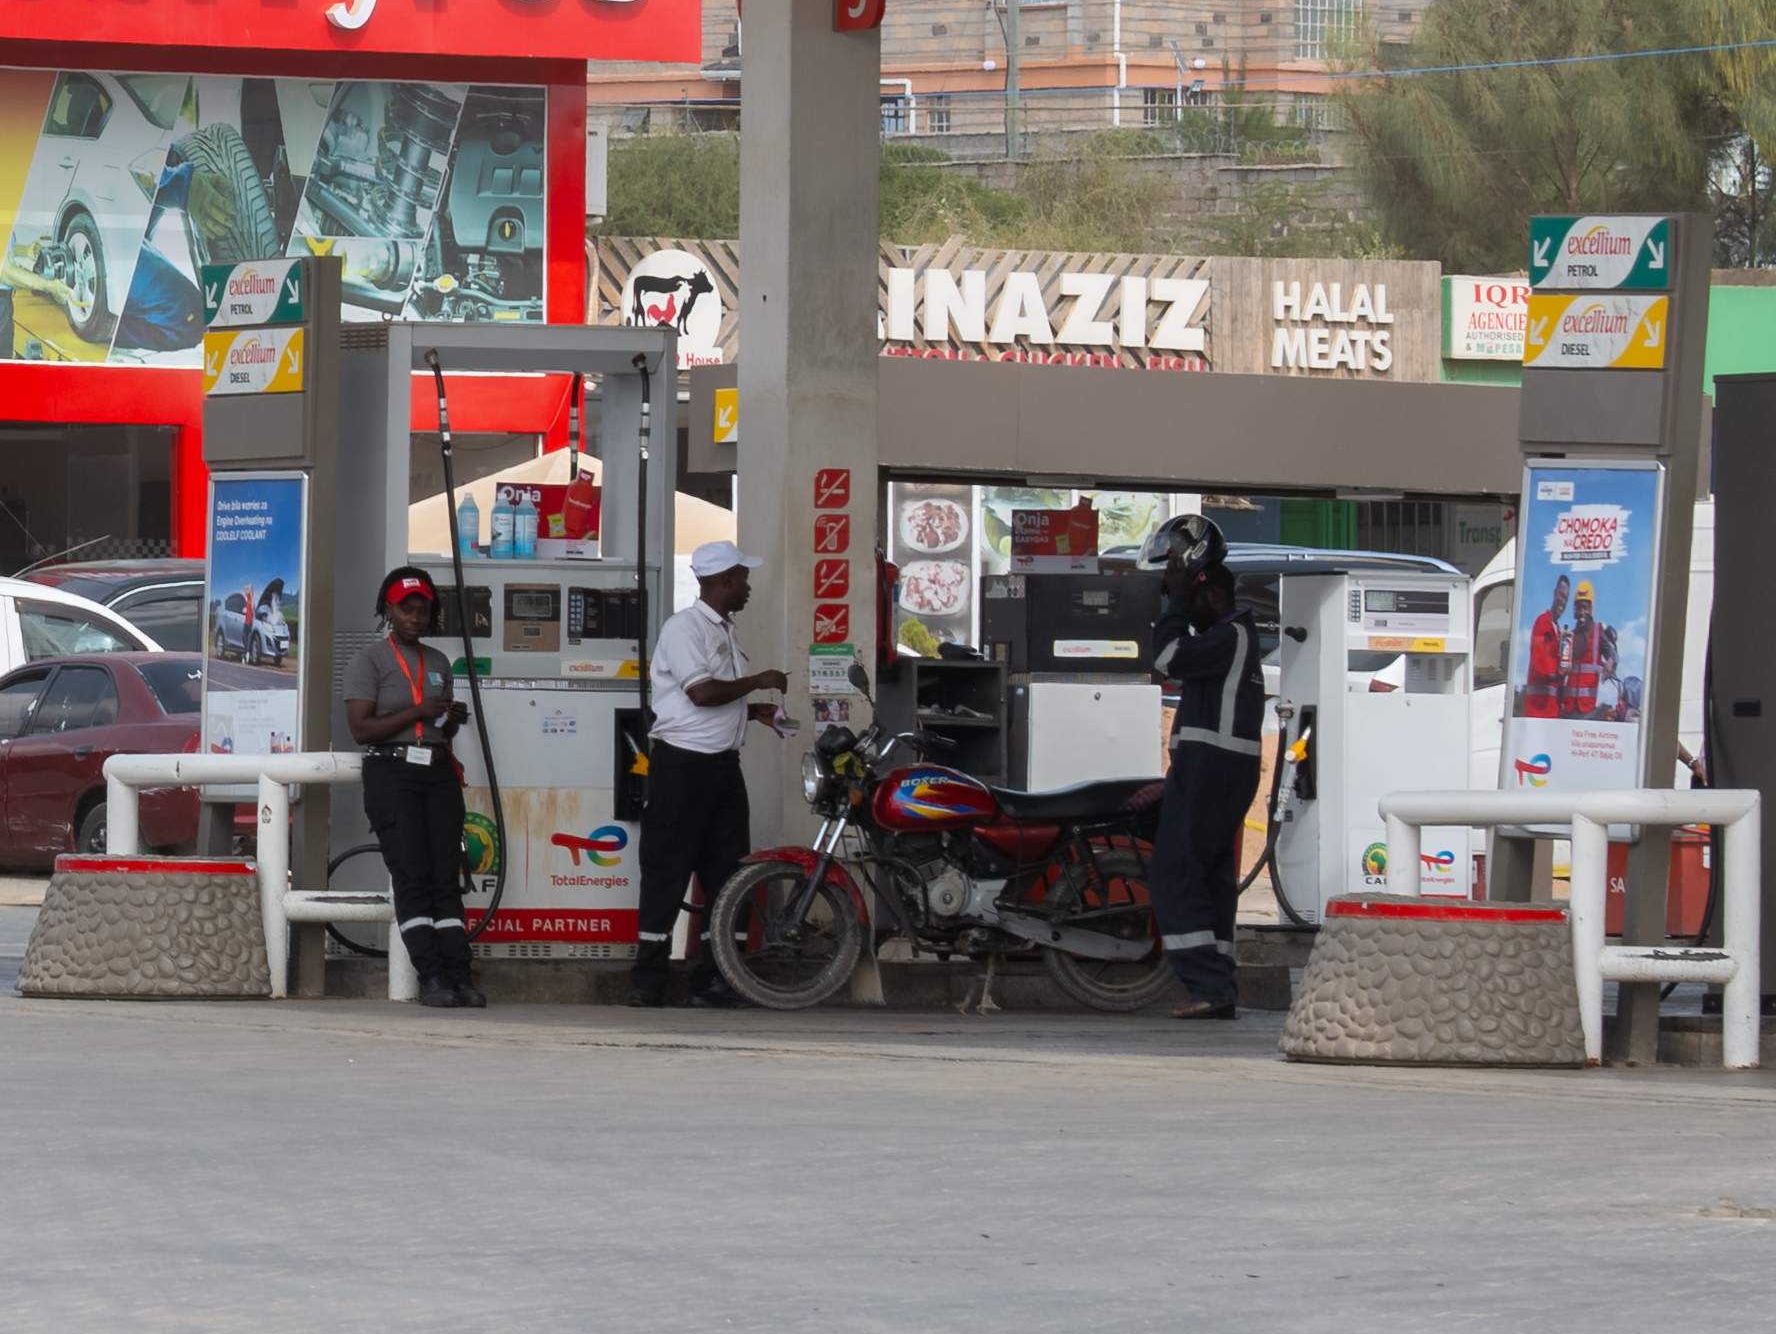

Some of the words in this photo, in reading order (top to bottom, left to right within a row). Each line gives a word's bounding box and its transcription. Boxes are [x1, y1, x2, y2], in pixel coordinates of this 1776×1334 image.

[1567, 231, 1632, 256] excellium
[1567, 264, 1599, 277] PETROL
[229, 273, 276, 296] excellium
[230, 303, 253, 316] PETROL
[878, 267, 1210, 351] INAZIZ
[1273, 280, 1394, 325] HALAL
[1562, 309, 1628, 335] excellium
[1466, 331, 1523, 341] AUTHORISED
[230, 343, 276, 365] excellium
[1271, 327, 1393, 371] MEATS
[1561, 343, 1591, 356] DIESEL
[230, 372, 251, 384] DIESEL
[1014, 512, 1050, 528] Onja
[1558, 518, 1618, 534] CHOMOKA
[240, 529, 267, 540] COOLANT
[1573, 534, 1613, 550] CREDO
[551, 874, 629, 889] TotalEnergies
[532, 918, 612, 933] PARTNER
